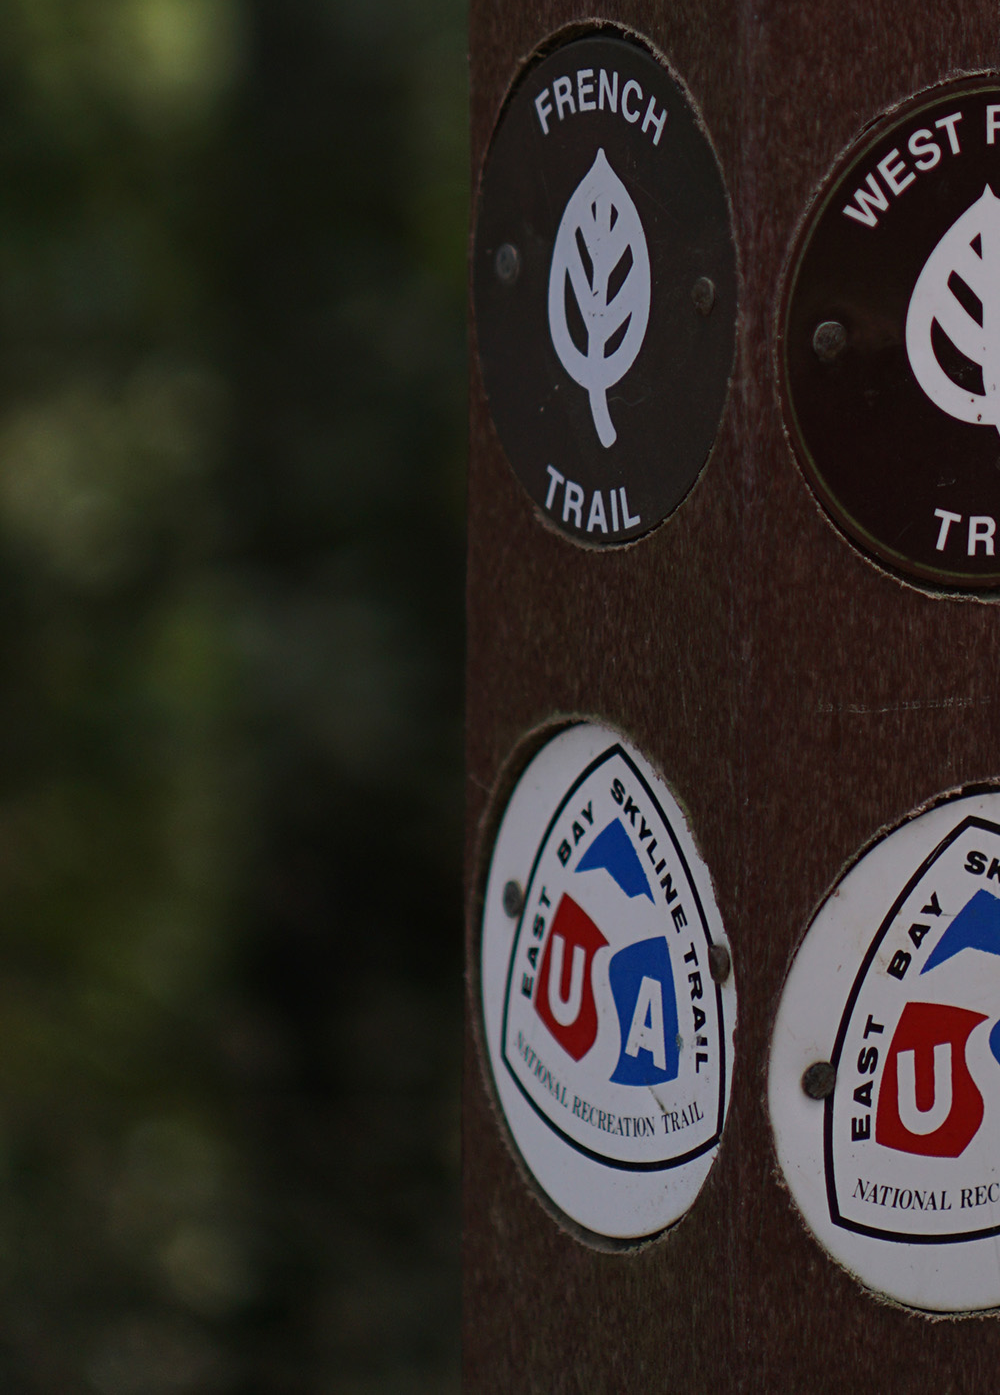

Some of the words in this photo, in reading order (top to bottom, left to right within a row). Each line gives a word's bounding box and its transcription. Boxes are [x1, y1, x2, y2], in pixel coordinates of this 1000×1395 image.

[534, 68, 668, 146] FRENCH
[842, 112, 963, 230] WEST
[543, 464, 641, 534] TRAIL
[521, 886, 552, 999] EAST
[555, 800, 595, 868] BAY
[610, 777, 687, 934] SKYLINE
[684, 942, 709, 1074] TRAIL
[852, 1014, 884, 1142] EAST
[887, 892, 943, 981] BAY
[515, 1030, 568, 1106] NATIONAL
[573, 1097, 656, 1138] RECREATION
[662, 1101, 704, 1134] TRAIL
[852, 1178, 952, 1211] NATIONAL
